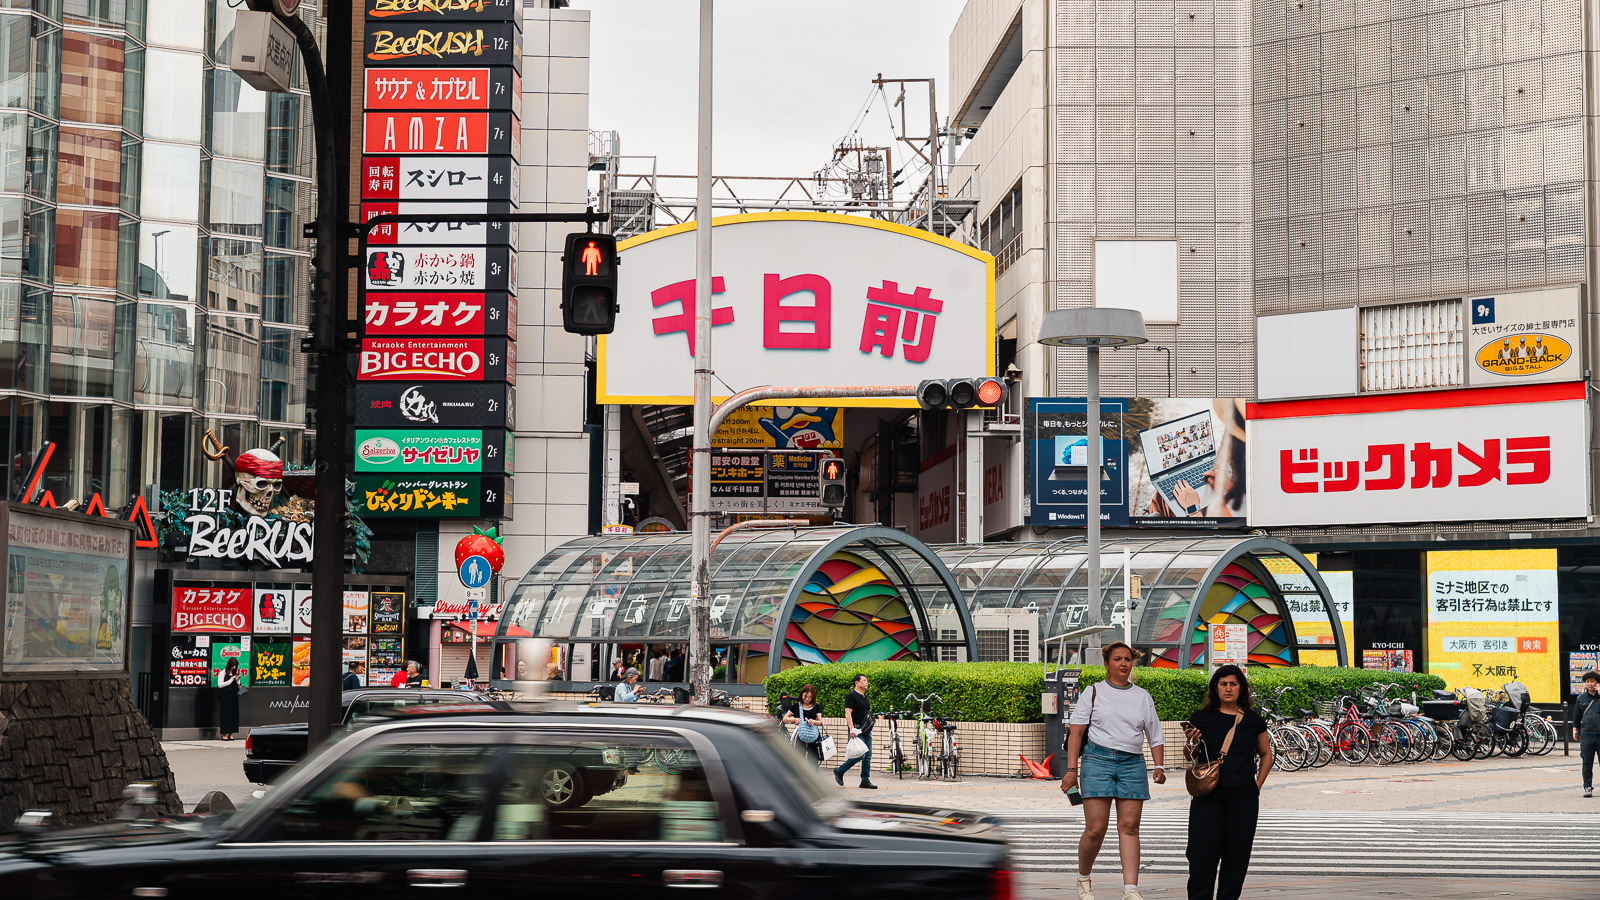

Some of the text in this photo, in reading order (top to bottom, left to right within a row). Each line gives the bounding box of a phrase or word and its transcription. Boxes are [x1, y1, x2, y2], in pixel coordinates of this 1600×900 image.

[493, 37, 509, 50] 12F
[494, 82, 505, 95] 7F
[384, 116, 504, 151] AMZA 7F
[368, 165, 394, 178] 回転
[404, 169, 503, 188] スシロー 4F
[368, 179, 393, 192] 寿司
[413, 253, 501, 276] 赤から鍋 3F
[413, 270, 475, 286] 赤から焼
[365, 301, 482, 327] カラオケ
[489, 307, 500, 320] 3F
[1477, 304, 1490, 317] 9F
[650, 273, 944, 364] 千日前
[1471, 318, 1576, 336] 大きいサイズの紳士服専門店
[371, 341, 468, 349] Karaoke Entertainment
[361, 351, 407, 375] BIG
[411, 351, 480, 374] ECHO
[488, 353, 500, 366] 3F
[1482, 353, 1563, 368] GRAND-BACK
[370, 400, 392, 409] 焼肉
[488, 399, 499, 412] 2F
[717, 437, 744, 445] straight
[402, 444, 498, 465] サイゼリヤ 2F
[772, 454, 785, 468] 薬
[1279, 435, 1551, 495] ビックカメラ
[397, 480, 468, 489] ハンバーグレストラン
[711, 485, 760, 493] なんば千日前店
[187, 487, 233, 514] 12F
[365, 488, 497, 512] びっくりドンキー 2F
[184, 514, 314, 569] BeeRUS
[1435, 580, 1509, 595] ミナミ地区での
[182, 589, 241, 604] カラオケ
[1435, 598, 1553, 613] 客引き行為は禁止です
[176, 612, 246, 629] BIG ECHO
[1449, 639, 1542, 650] 大阪市 客引き 検索
[257, 652, 285, 667] びっくり
[255, 665, 287, 681] ドンキー
[1485, 665, 1518, 677] 大阪市
